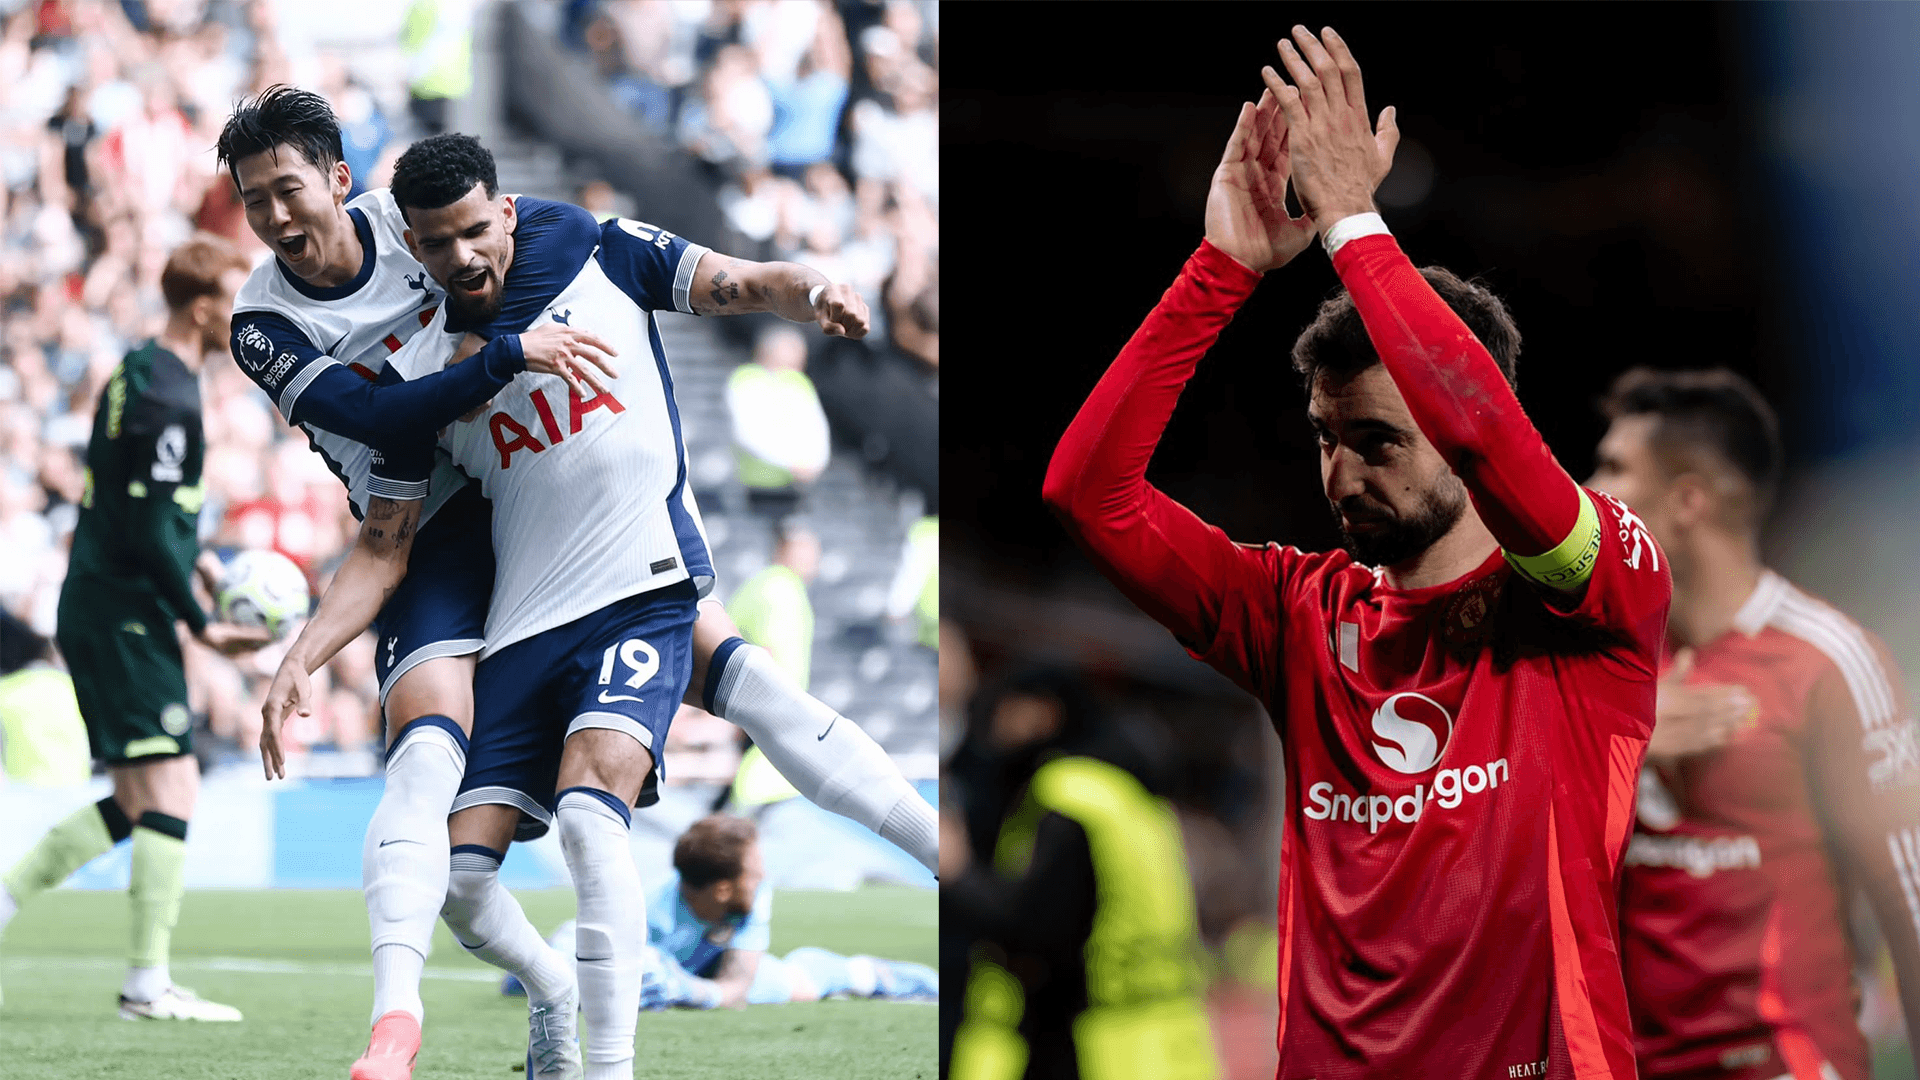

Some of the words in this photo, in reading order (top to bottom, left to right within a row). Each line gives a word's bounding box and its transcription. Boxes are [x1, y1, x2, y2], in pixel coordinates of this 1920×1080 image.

[262, 374, 272, 385] No
[270, 352, 289, 376] room
[275, 354, 298, 382] racism
[489, 367, 626, 469] AIA
[598, 639, 660, 689] 19
[1303, 758, 1509, 834] Snapdgon
[1508, 1056, 1550, 1079] HEAT.R
